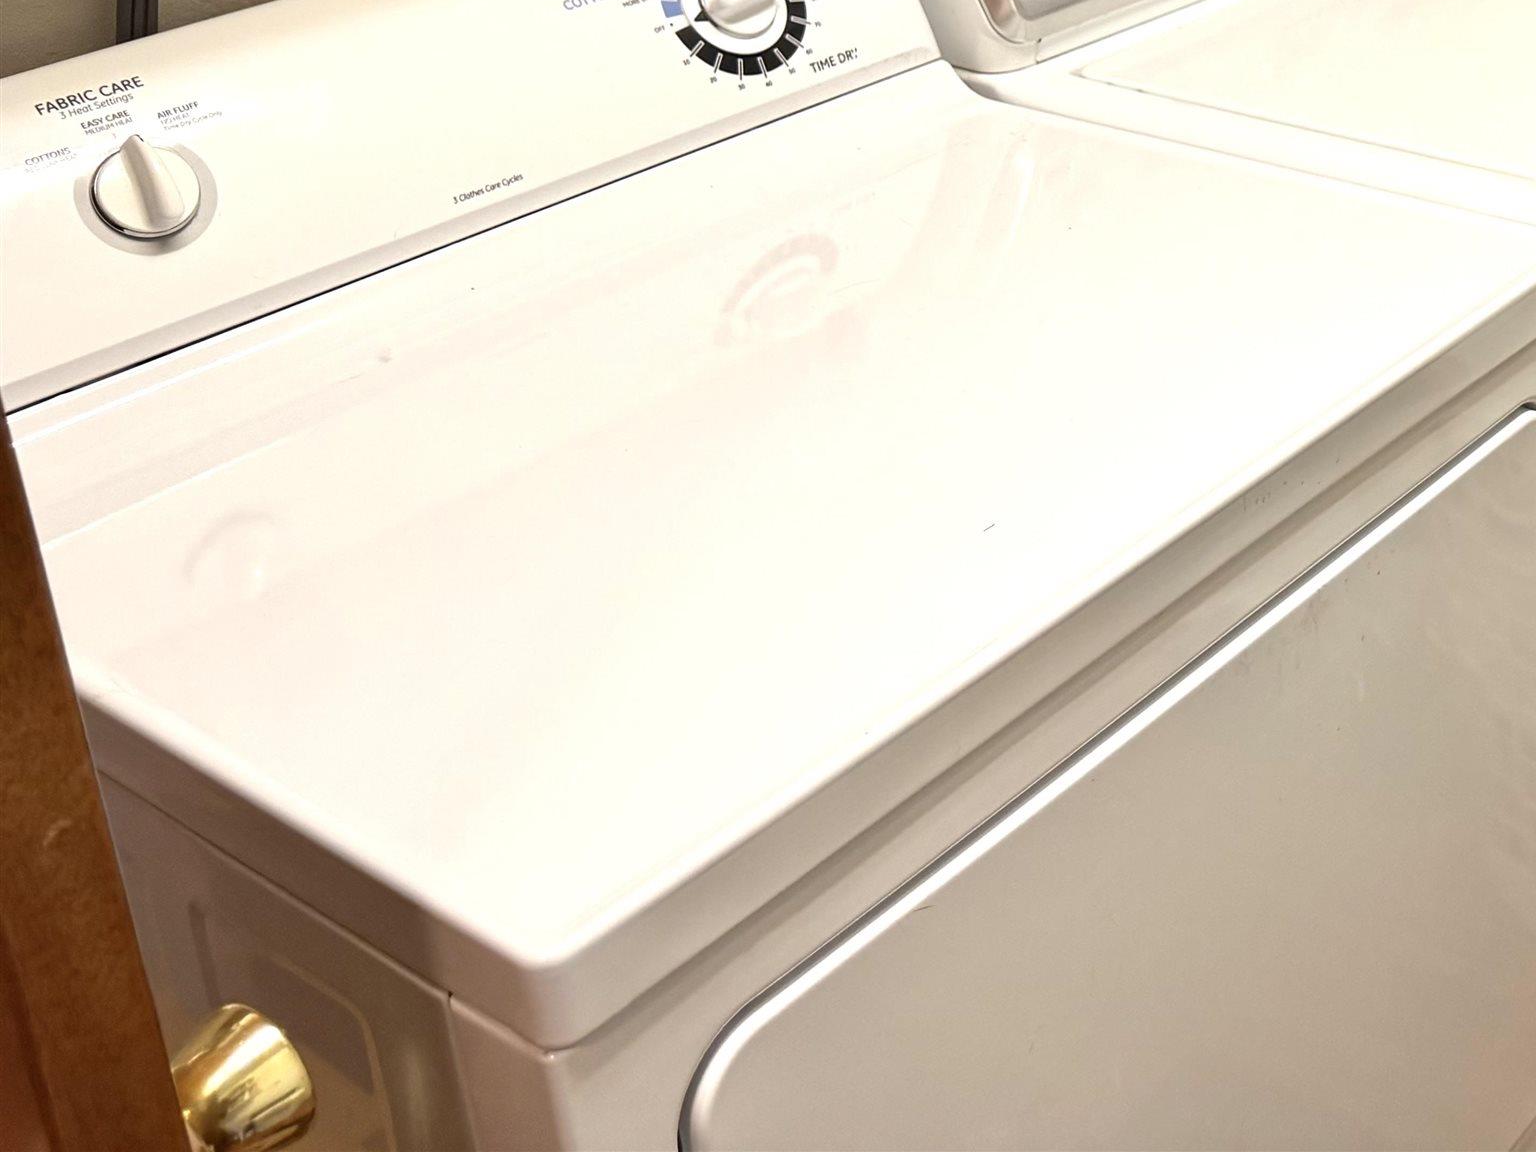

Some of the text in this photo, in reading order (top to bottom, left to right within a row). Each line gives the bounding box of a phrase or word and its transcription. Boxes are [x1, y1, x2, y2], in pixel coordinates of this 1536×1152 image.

[809, 54, 837, 74] TIME
[34, 75, 144, 116] FABRIC CARE
[60, 92, 134, 120] 3 Heat Settings
[80, 109, 131, 131] EASY CARE
[156, 100, 200, 120] AIR FLUFF
[84, 122, 115, 136] MEDIUM
[24, 147, 72, 166] COTTONS
[459, 188, 485, 202] Clothes
[485, 182, 501, 193] Care
[501, 173, 524, 187] Cycles
